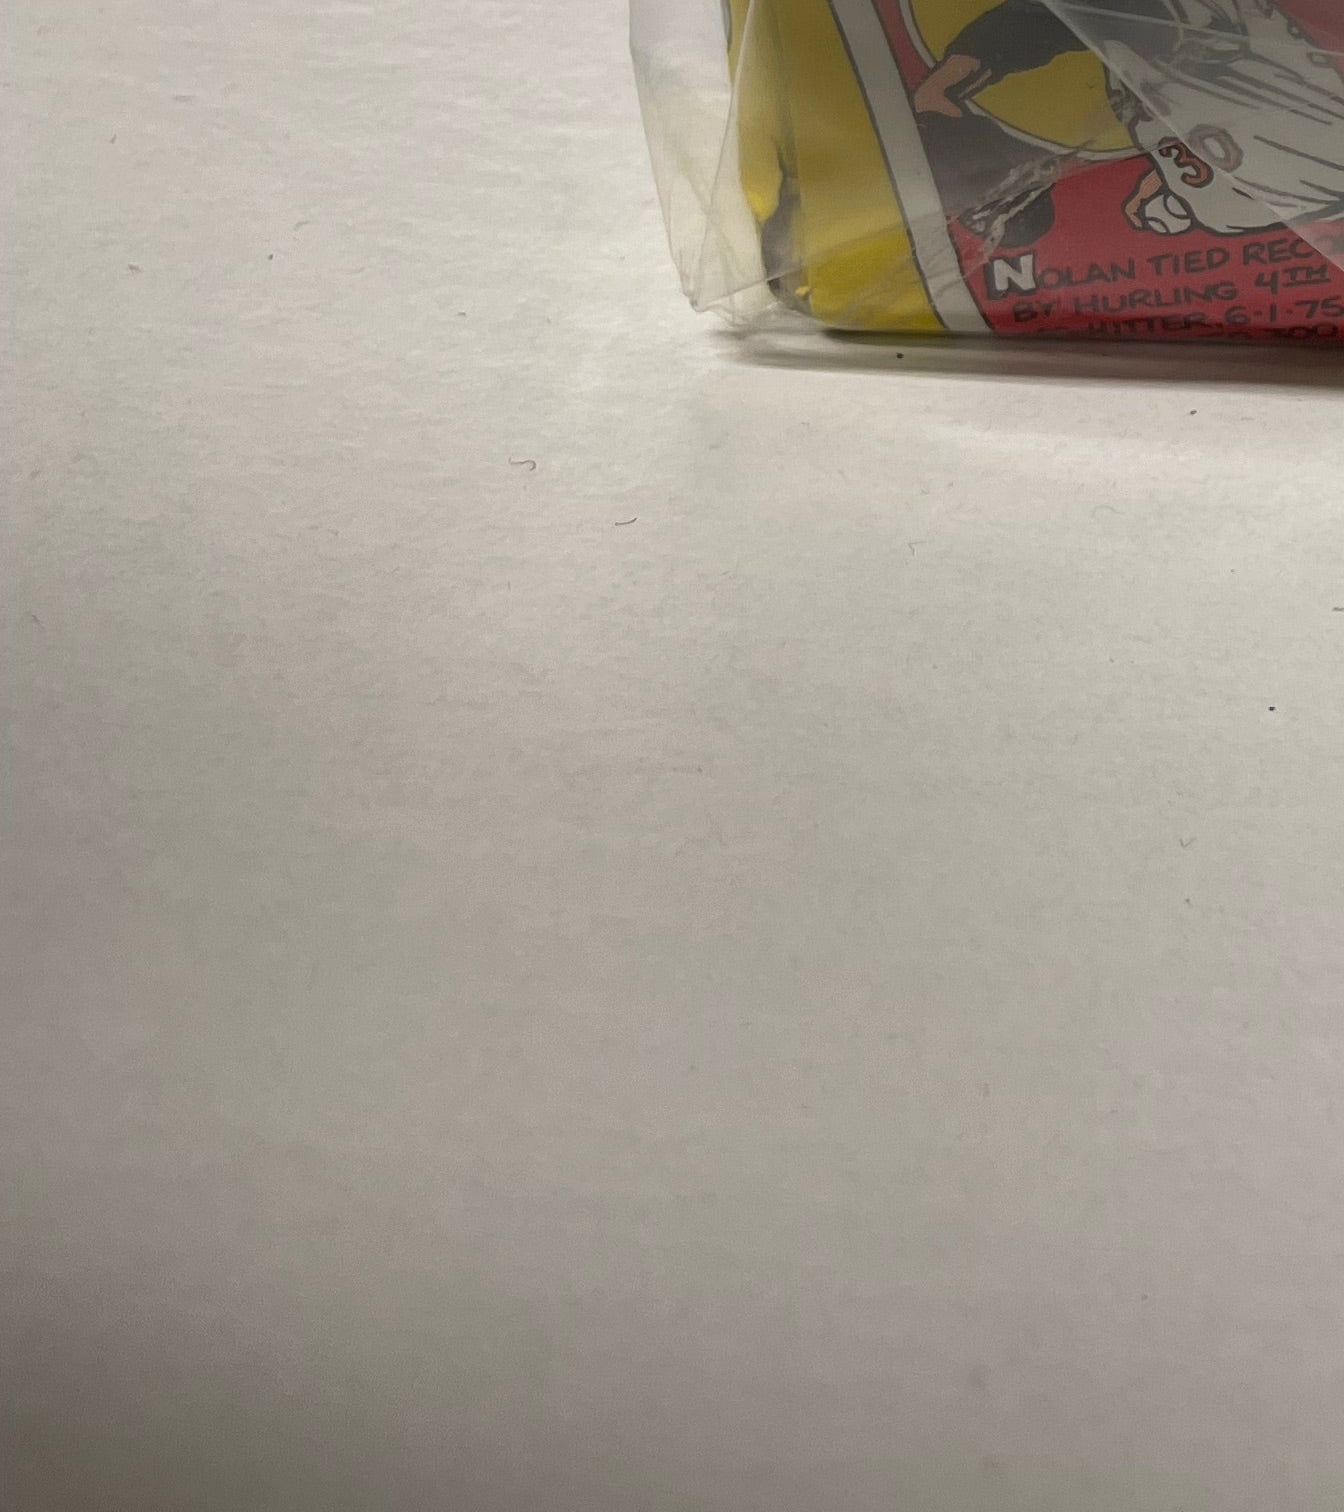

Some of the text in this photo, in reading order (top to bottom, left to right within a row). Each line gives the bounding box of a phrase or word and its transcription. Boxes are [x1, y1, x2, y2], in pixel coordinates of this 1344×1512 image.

[986, 251, 1136, 300] NOLAN
[1146, 246, 1230, 277] TIED
[1012, 299, 1061, 323] BY
[1073, 277, 1239, 314] HURLING
